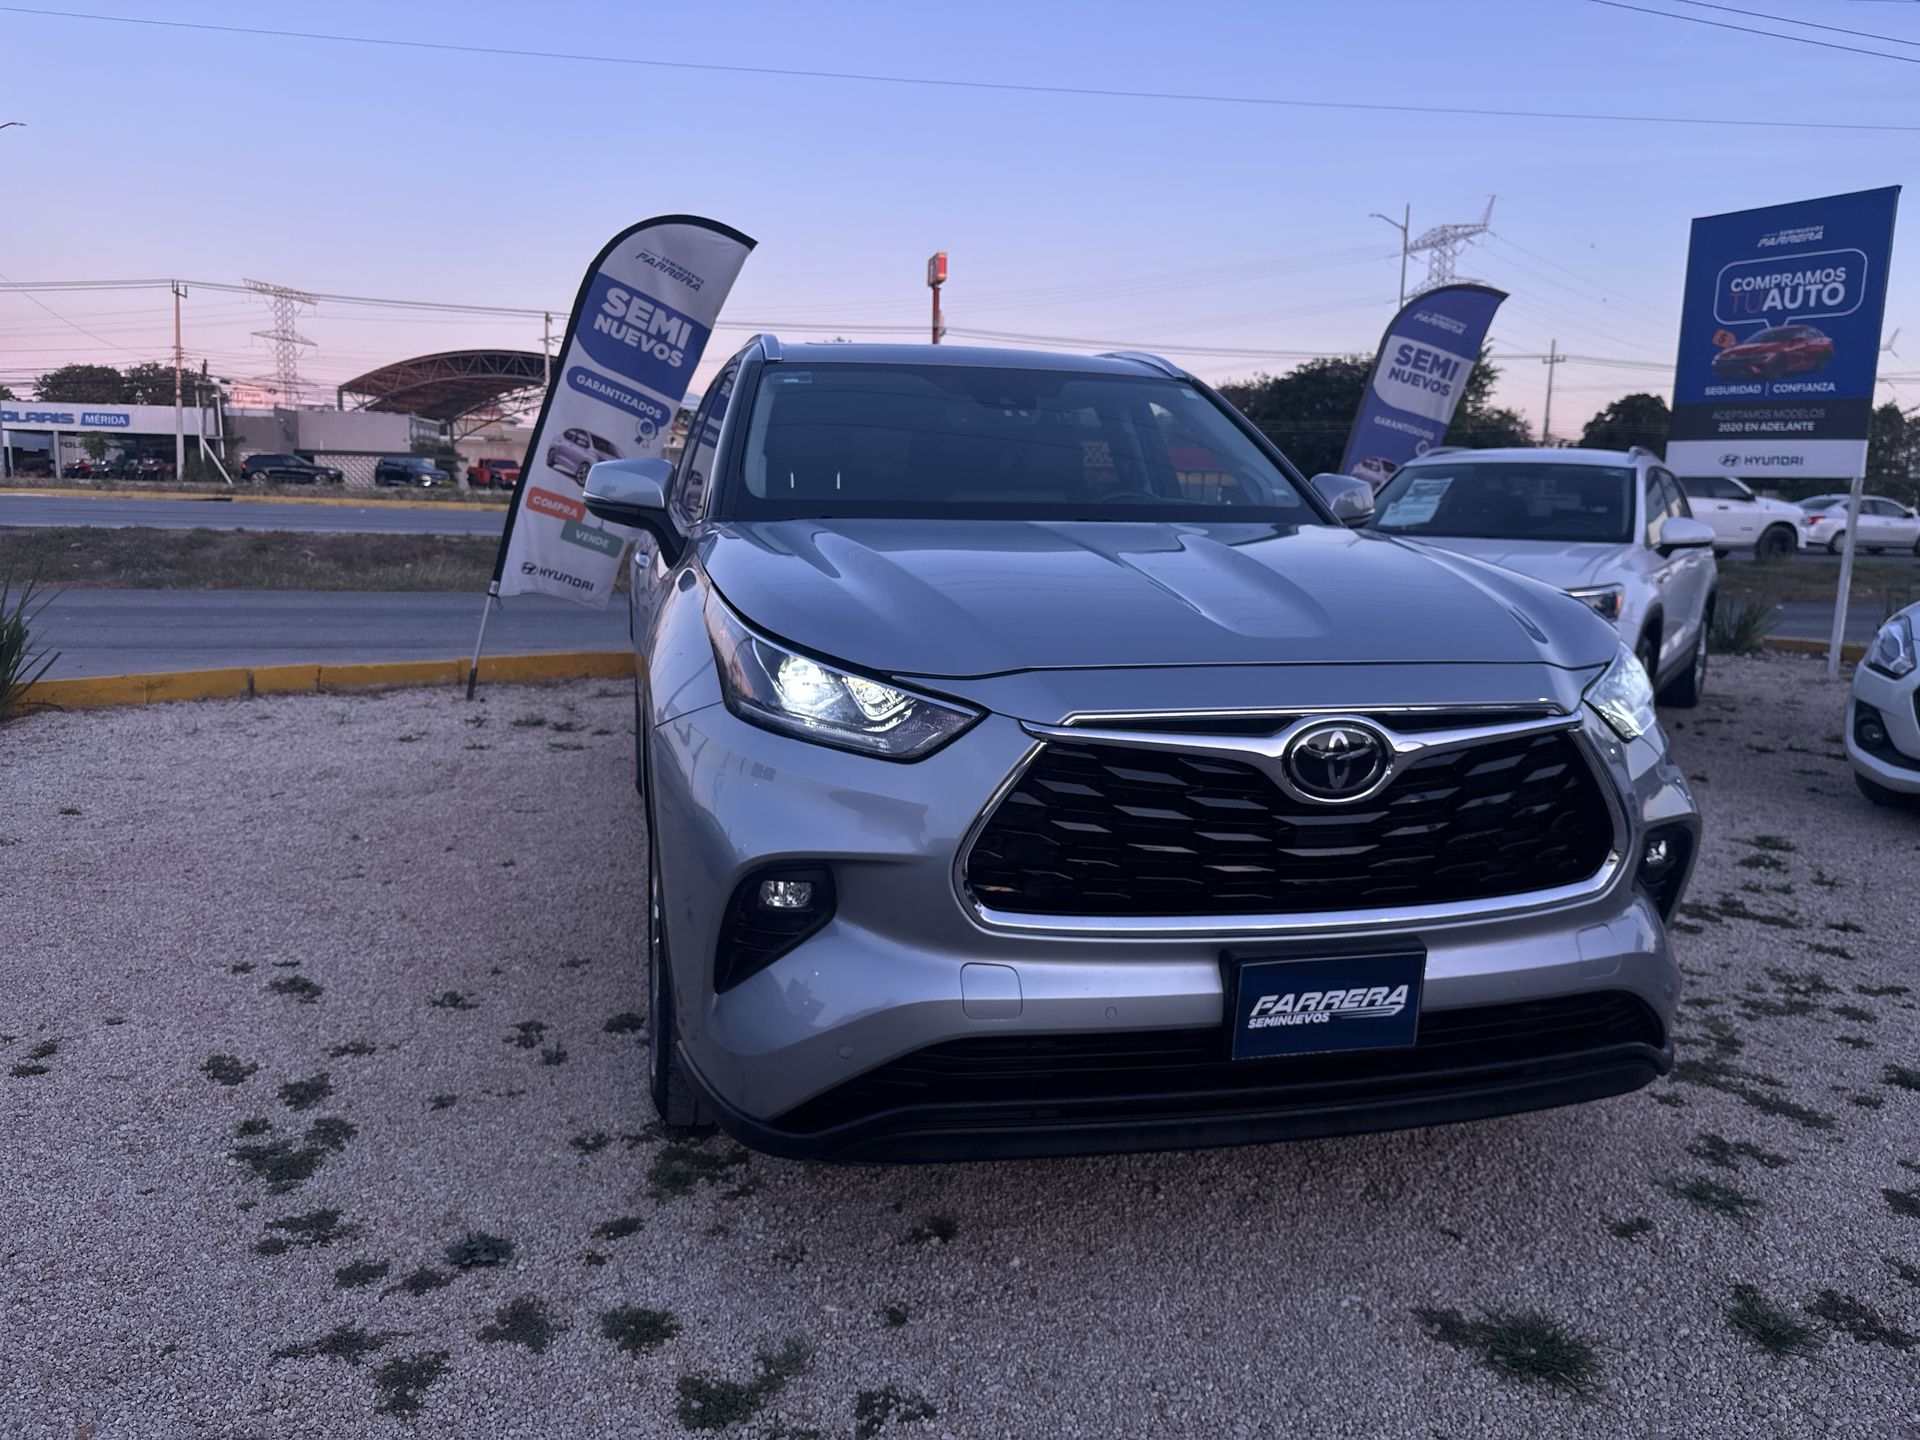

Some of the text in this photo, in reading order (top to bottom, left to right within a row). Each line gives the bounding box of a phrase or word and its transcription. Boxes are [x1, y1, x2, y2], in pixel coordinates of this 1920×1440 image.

[635, 252, 701, 292] FARRERA
[1730, 267, 1846, 292] COMPRAMOS
[1729, 282, 1846, 315] TU AUTO
[601, 287, 693, 350] SEMI
[593, 313, 684, 368] NUEVOS
[1394, 344, 1461, 382] SEMI
[1388, 367, 1452, 397] NUEVOS
[1704, 382, 1836, 396] SEGURIDAD CONFIANZA
[576, 374, 663, 420] GARANTIZADOS
[84, 413, 127, 425] MÉRIDA
[1773, 407, 1826, 419] MODELOS
[1718, 421, 1815, 432] 2020 EN ADELANTE
[1744, 456, 1804, 466] HYUNDAI
[533, 495, 579, 518] COMPRA
[575, 529, 610, 549] VENDE
[539, 567, 594, 592] HYUNDAI
[1249, 984, 1409, 1016] FARRERA
[1248, 1012, 1330, 1029] SEMINUEVOS
